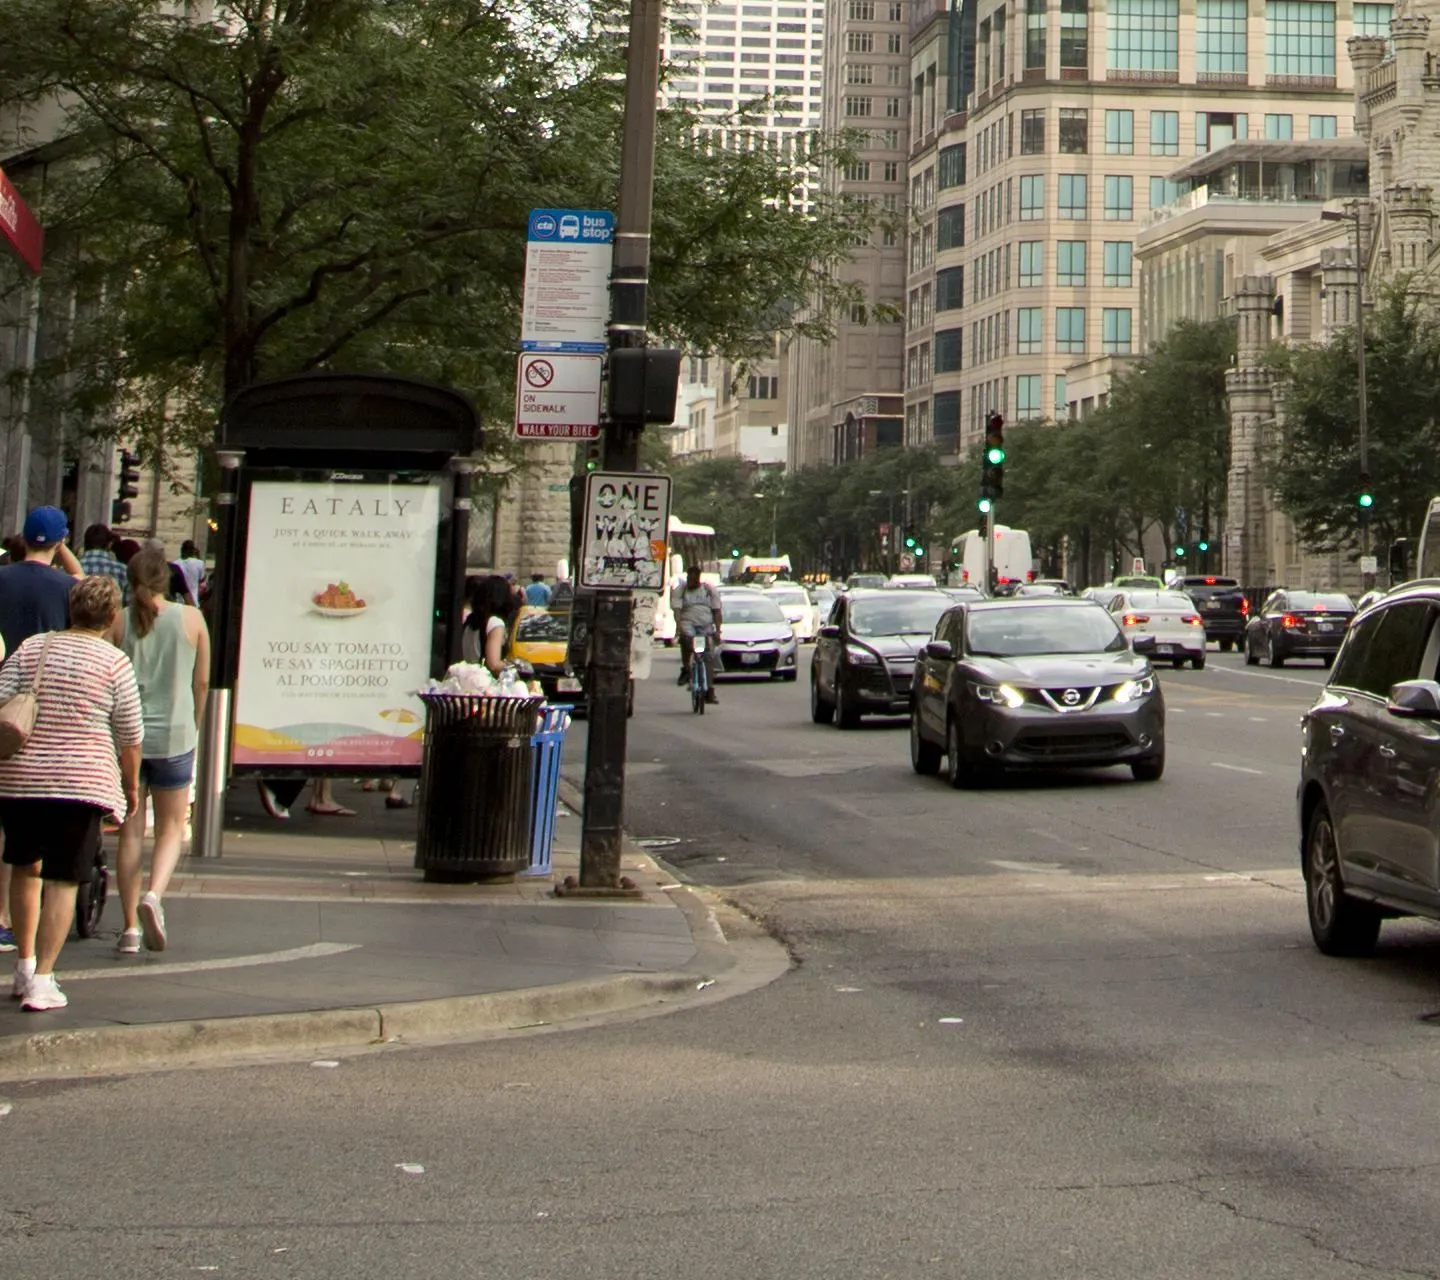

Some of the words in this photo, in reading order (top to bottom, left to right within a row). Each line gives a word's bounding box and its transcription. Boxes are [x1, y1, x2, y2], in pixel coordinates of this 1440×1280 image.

[583, 215, 606, 227] bus
[582, 228, 610, 240] stop
[523, 394, 536, 403] ON
[523, 404, 566, 413] SIDEWALK
[522, 424, 546, 436] WALK
[548, 425, 570, 437] YOUR
[572, 425, 593, 437] BIKE
[598, 483, 661, 510] ONE
[281, 497, 412, 516] EATALY
[274, 529, 298, 538] JUST
[303, 529, 310, 537] A
[313, 529, 347, 539] QUICK
[351, 530, 381, 538] WALK
[385, 530, 413, 539] AWAY
[595, 515, 661, 541] WAY
[268, 641, 300, 653] YOU
[303, 642, 331, 654] SAY
[335, 642, 404, 656] TOMATO,
[262, 658, 285, 669] WE
[288, 658, 316, 670] SAY
[319, 659, 409, 672] SPAGHETTO
[276, 674, 297, 686] AL
